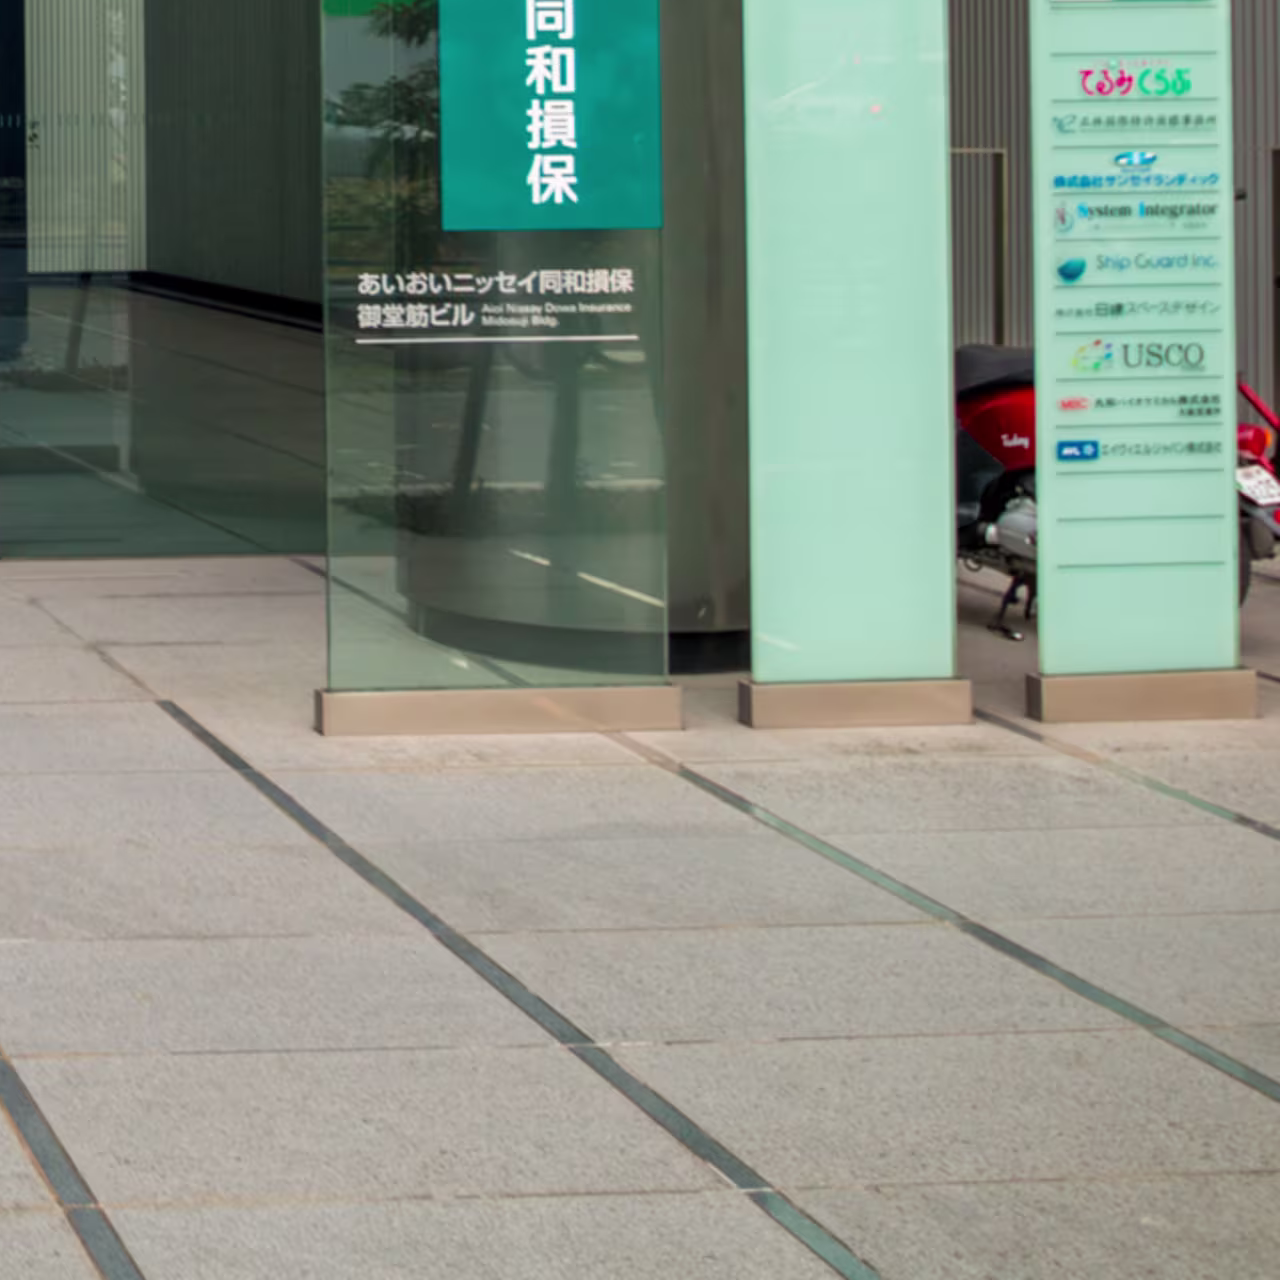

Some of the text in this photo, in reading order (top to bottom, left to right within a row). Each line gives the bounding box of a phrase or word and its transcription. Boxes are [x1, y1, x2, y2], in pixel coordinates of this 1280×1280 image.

[1079, 68, 1193, 97] てるみくらぶ
[1077, 200, 1218, 221] System Integrator
[1096, 253, 1132, 272] Ship
[1134, 252, 1189, 270] Guard
[356, 269, 636, 296] あいおいニッセイ同和損保
[357, 302, 476, 329] 御堂筋ビル
[578, 301, 632, 313] Insurance
